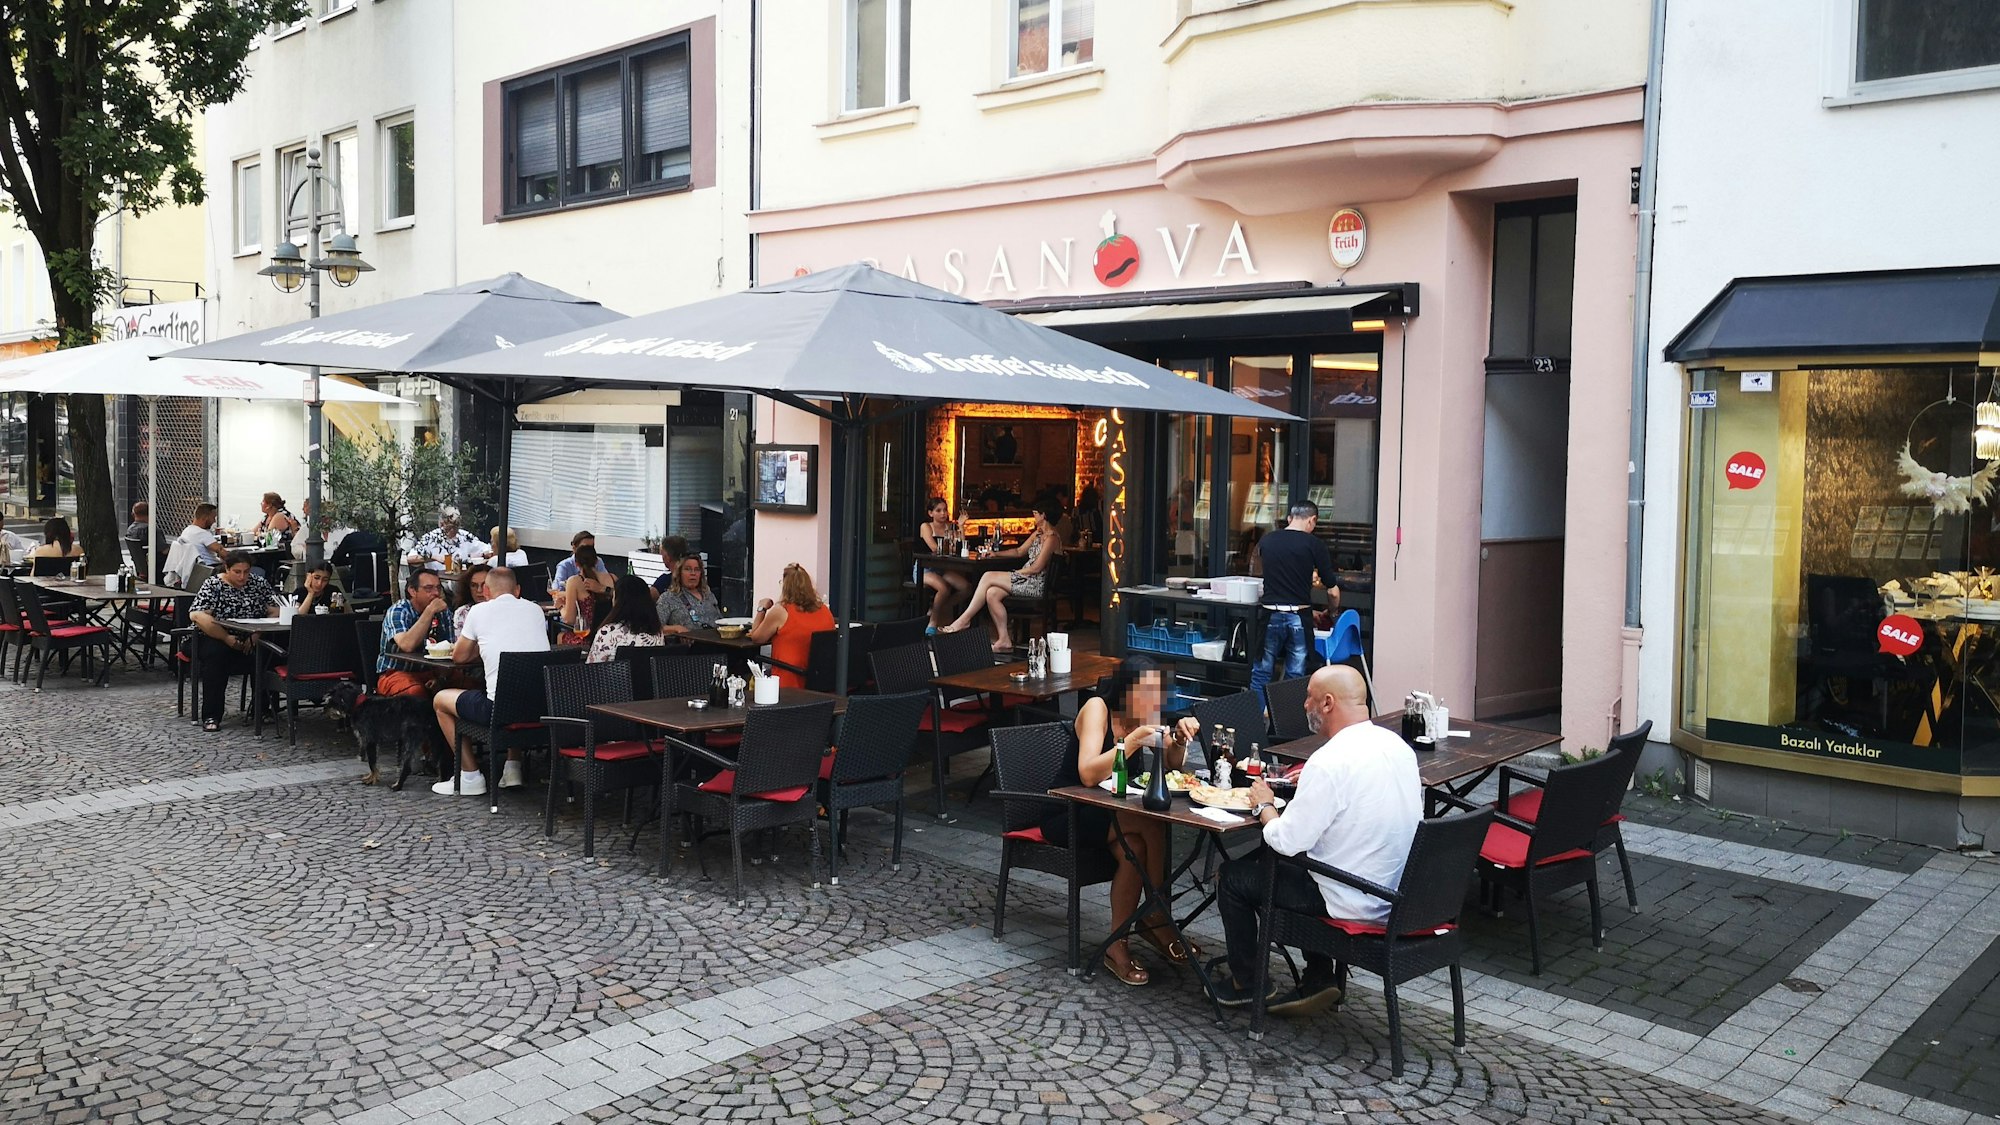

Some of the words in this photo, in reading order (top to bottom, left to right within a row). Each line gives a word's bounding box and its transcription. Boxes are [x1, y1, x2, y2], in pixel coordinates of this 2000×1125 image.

[923, 351, 1031, 377] Gaffel
[1534, 357, 1554, 374] 23
[729, 407, 739, 421] 21
[1727, 461, 1764, 480] SALE
[1879, 624, 1919, 648] SALE
[1780, 733, 1822, 753] Bazalı
[1825, 739, 1882, 759] Yataklar
